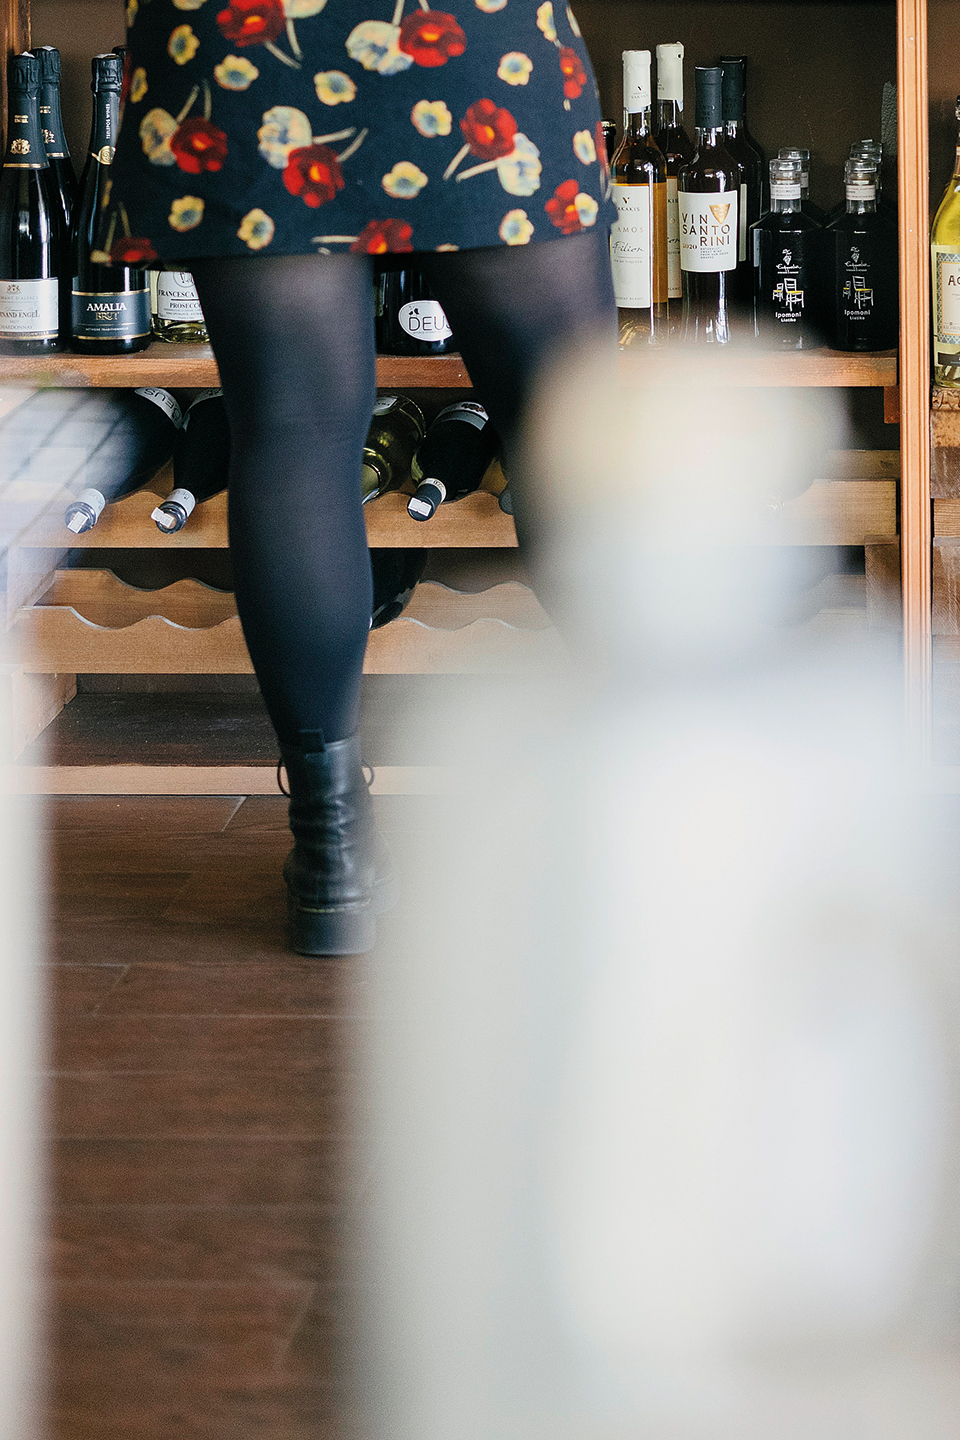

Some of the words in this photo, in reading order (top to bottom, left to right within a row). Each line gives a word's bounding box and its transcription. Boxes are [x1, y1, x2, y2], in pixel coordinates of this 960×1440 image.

[682, 213, 707, 224] VIN
[682, 224, 730, 235] SANTO
[700, 235, 730, 246] RINI
[86, 303, 127, 311] AMALIA
